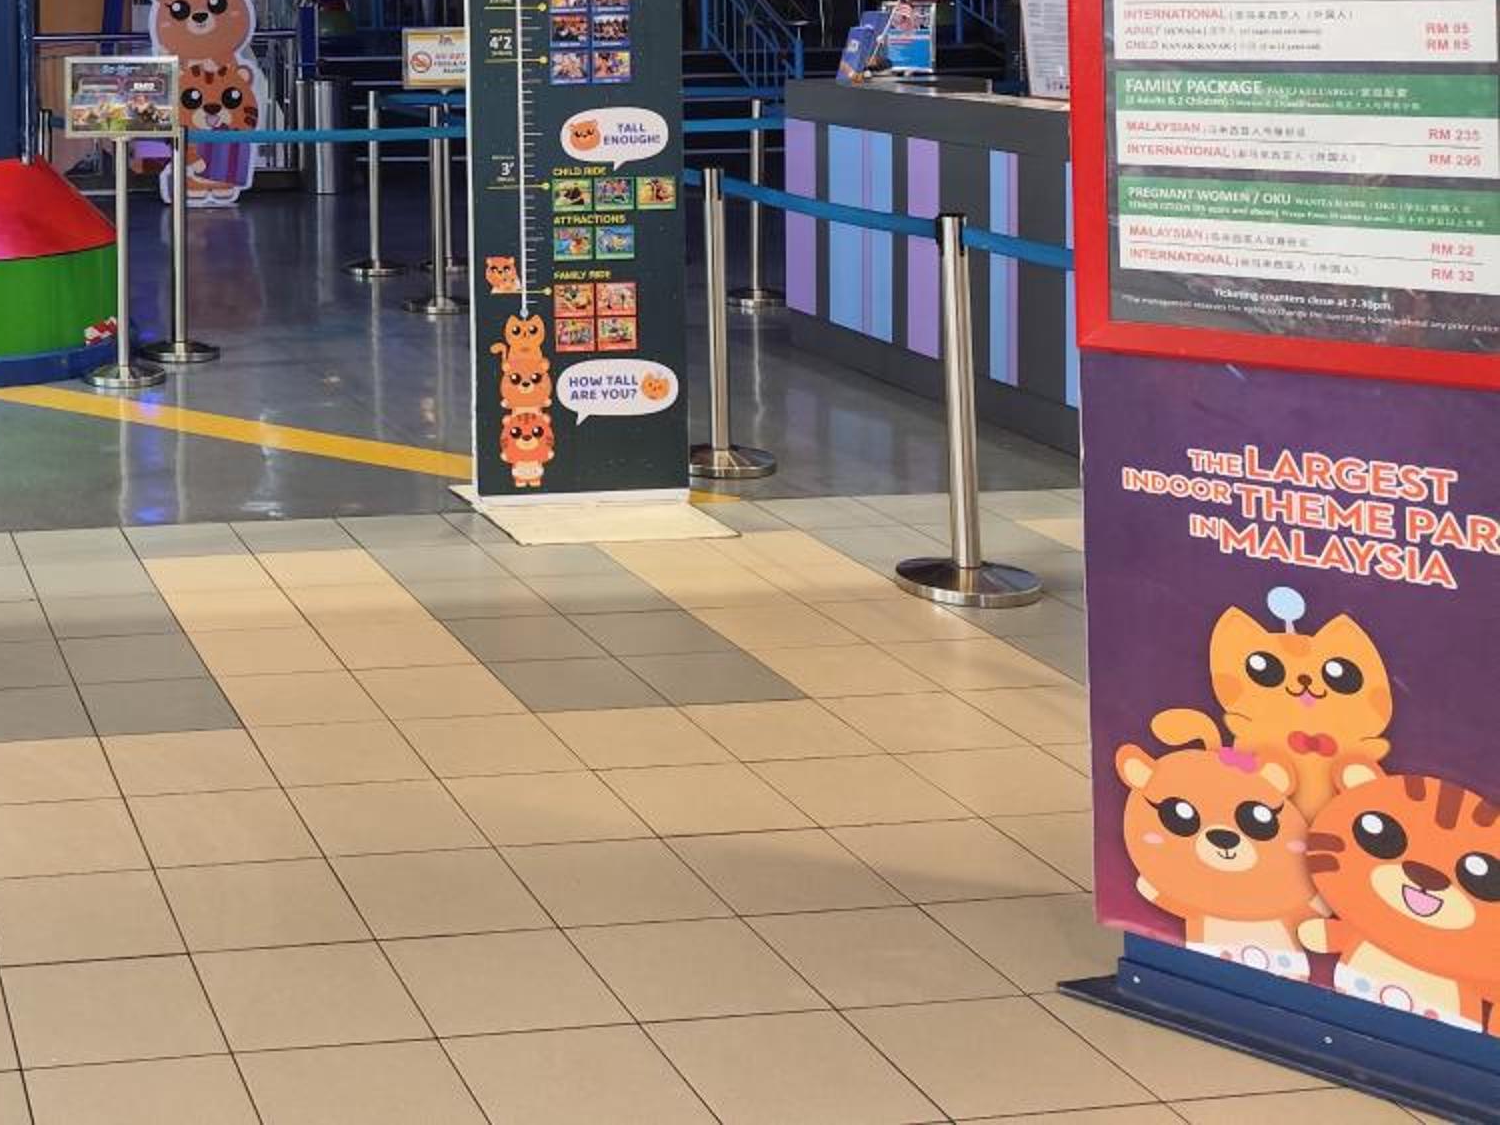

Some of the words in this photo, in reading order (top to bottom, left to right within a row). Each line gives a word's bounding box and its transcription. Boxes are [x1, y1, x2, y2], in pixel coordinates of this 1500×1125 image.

[1123, 8, 1225, 20] INTERNATIONAL
[1426, 22, 1448, 34] RM
[1427, 38, 1449, 50] RM
[1125, 78, 1182, 93] FAMILY
[1187, 80, 1262, 94] PACKAGE
[617, 122, 646, 133] TALL
[1125, 121, 1201, 133] MALAYSIAN
[603, 133, 661, 146] ENOUGH!
[1428, 128, 1450, 140] RM
[1126, 143, 1230, 158] INTERNATIONAL
[1429, 154, 1451, 165] RM
[1455, 155, 1482, 166] 295
[553, 167, 580, 177] CHILD
[1128, 186, 1194, 201] PREGNANT
[1198, 189, 1250, 202] WOMEN
[1263, 192, 1292, 204] OKU
[553, 215, 627, 225] ATTRACTIONS
[1129, 226, 1203, 239] MALAYSIAN
[1431, 242, 1453, 255] RM
[1129, 248, 1231, 265] INTERNATIONAL
[553, 270, 587, 280] FAMILY
[1431, 269, 1453, 280] RM
[1214, 288, 1258, 302] Ticketing
[1260, 293, 1305, 304] counters
[1337, 297, 1348, 307] at
[568, 376, 603, 389] HOW
[606, 375, 639, 387] TALL
[570, 387, 597, 401] ARE
[601, 385, 638, 400] YOU?
[1187, 448, 1243, 477] THE
[1244, 445, 1458, 505] LARGEST
[1122, 466, 1232, 504] INDOOR
[1234, 481, 1396, 540] THEME
[1406, 506, 1500, 555] PAR
[1189, 513, 1218, 541] IN
[1219, 517, 1458, 589] MALAYSIA
